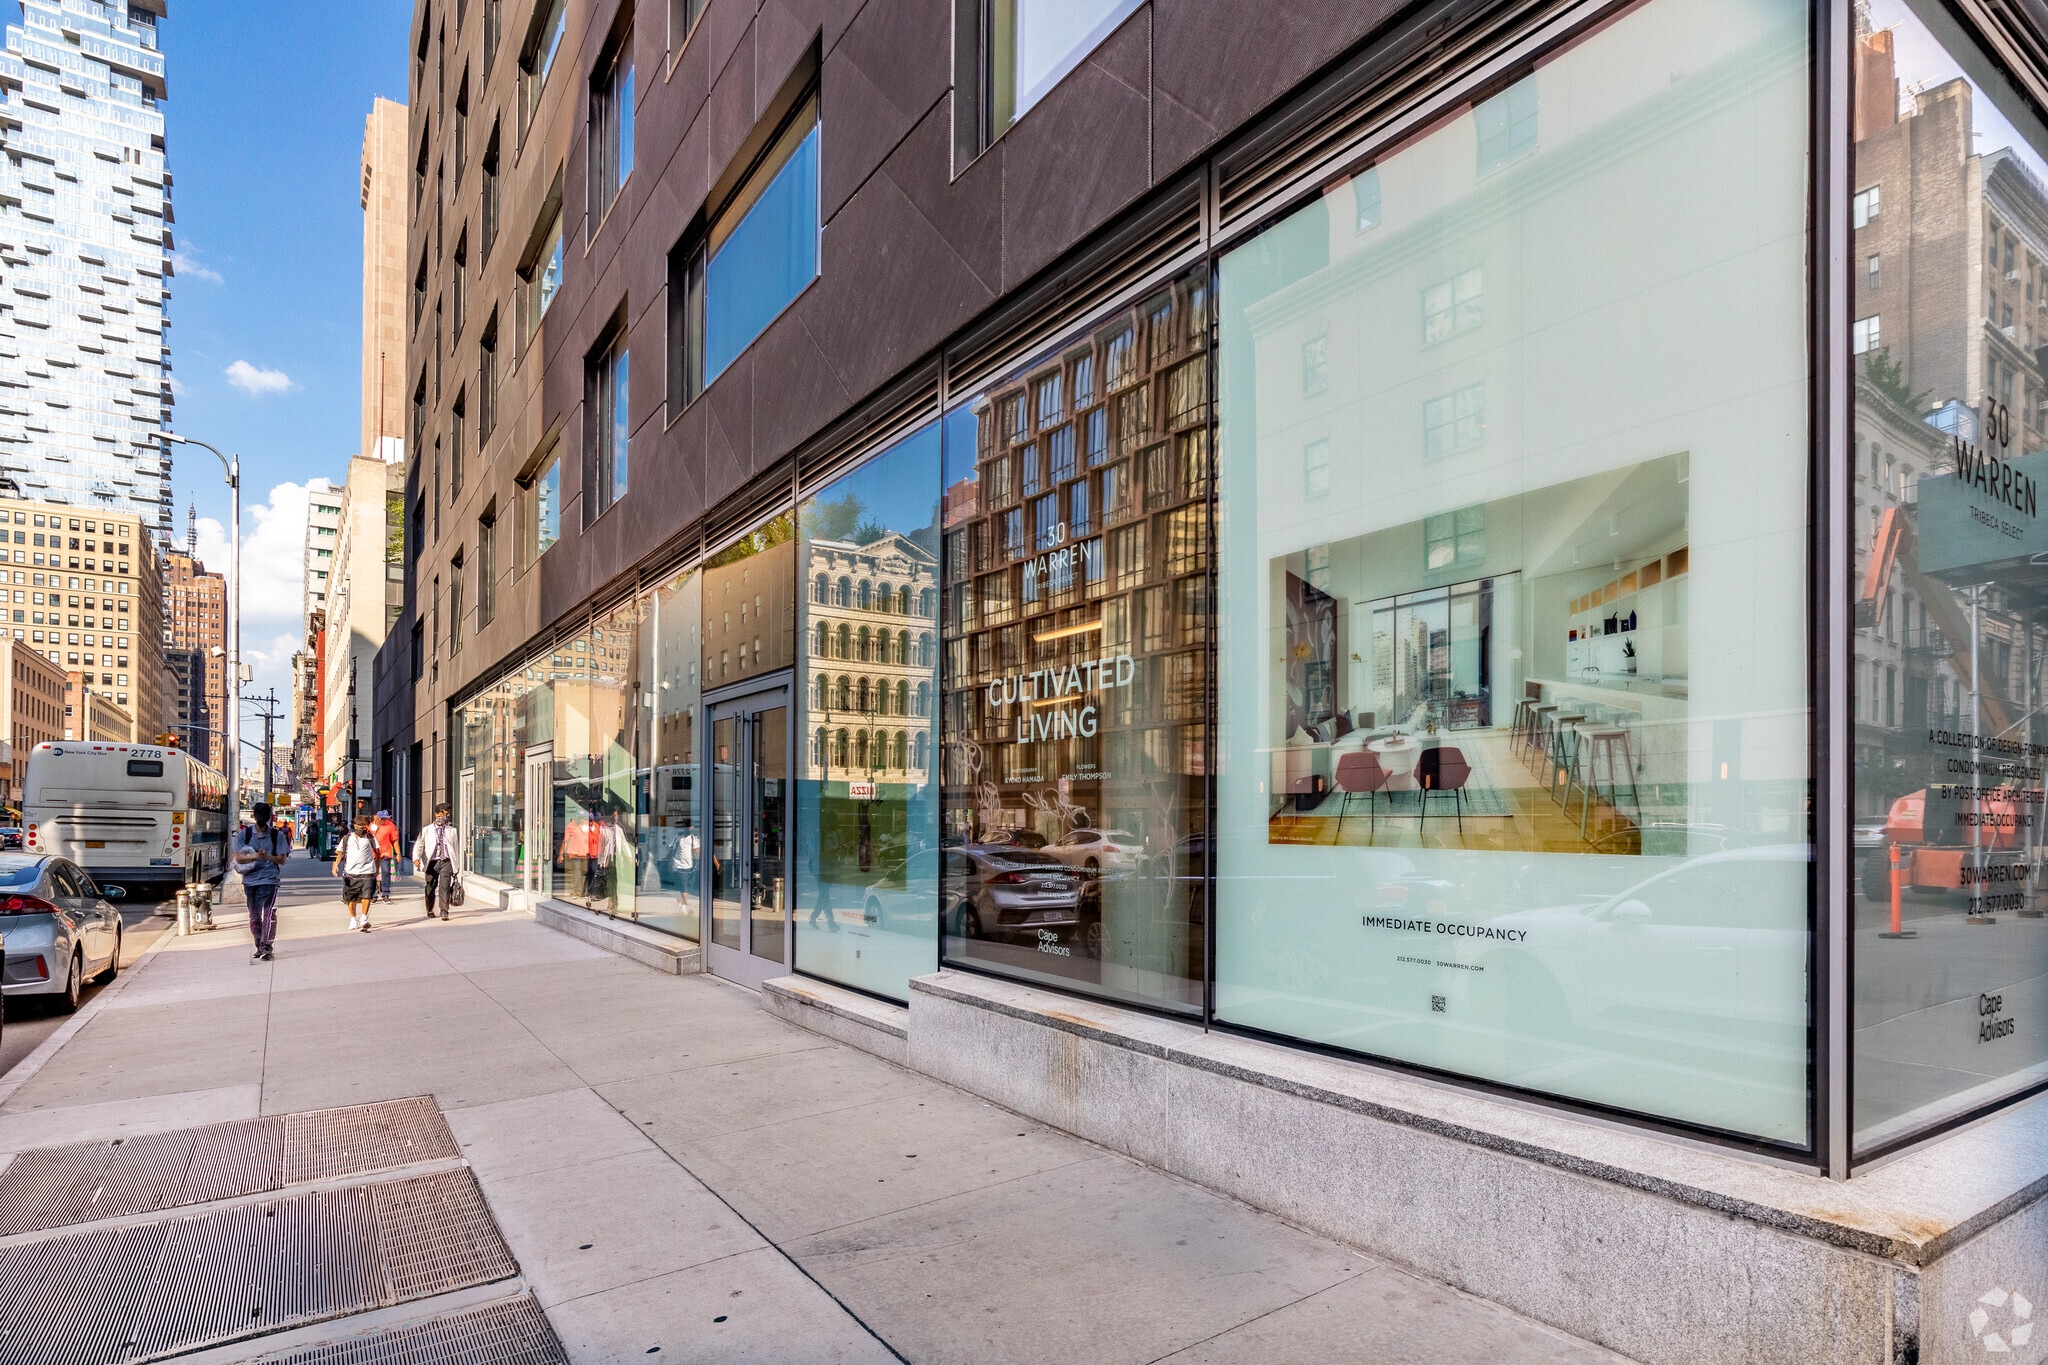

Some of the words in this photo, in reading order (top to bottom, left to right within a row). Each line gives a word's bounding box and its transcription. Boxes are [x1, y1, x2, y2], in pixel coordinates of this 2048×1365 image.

[1986, 395, 2009, 448] 30
[1955, 435, 2036, 518] WARREN
[1046, 521, 1066, 547] 30
[1970, 505, 1999, 531] TRIBECA
[2001, 521, 2024, 541] SELECT
[1023, 539, 1092, 579] WARREN
[988, 654, 1135, 707] CULTIVATED
[1016, 706, 1097, 744] LIVING
[1928, 729, 1935, 743] A
[1937, 730, 1985, 751] COLLECTION
[1987, 737, 1997, 751] OF
[131, 748, 162, 759] 2778
[1004, 776, 1021, 784] KYOKO
[1022, 775, 1045, 783] HAMADA
[1062, 773, 1078, 781] EMILY
[1079, 772, 1112, 780] THOMPSON
[1947, 758, 2001, 777] CONDOMINIUM
[2002, 764, 2041, 781] RESIDENCES
[1942, 784, 1952, 799] BY
[1954, 786, 2001, 801] POST-OFFICE
[1955, 812, 1995, 827] IMMEDIATE
[1996, 813, 2035, 827] OCCUPANCY
[1960, 864, 2031, 885] 30WARREN.COM
[1968, 892, 2025, 915] 212.577.0030
[1037, 928, 1058, 942] Cape
[1362, 915, 1432, 933] IMMEDIATE
[1436, 922, 1527, 942] OCCUPANCY
[1037, 941, 1070, 957] Advisors
[1396, 955, 1432, 965] 212.577.0030
[1436, 961, 1484, 972] 30WARREN.COM
[1979, 993, 2002, 1019] Cape
[1978, 1018, 2015, 1044] Advisors
